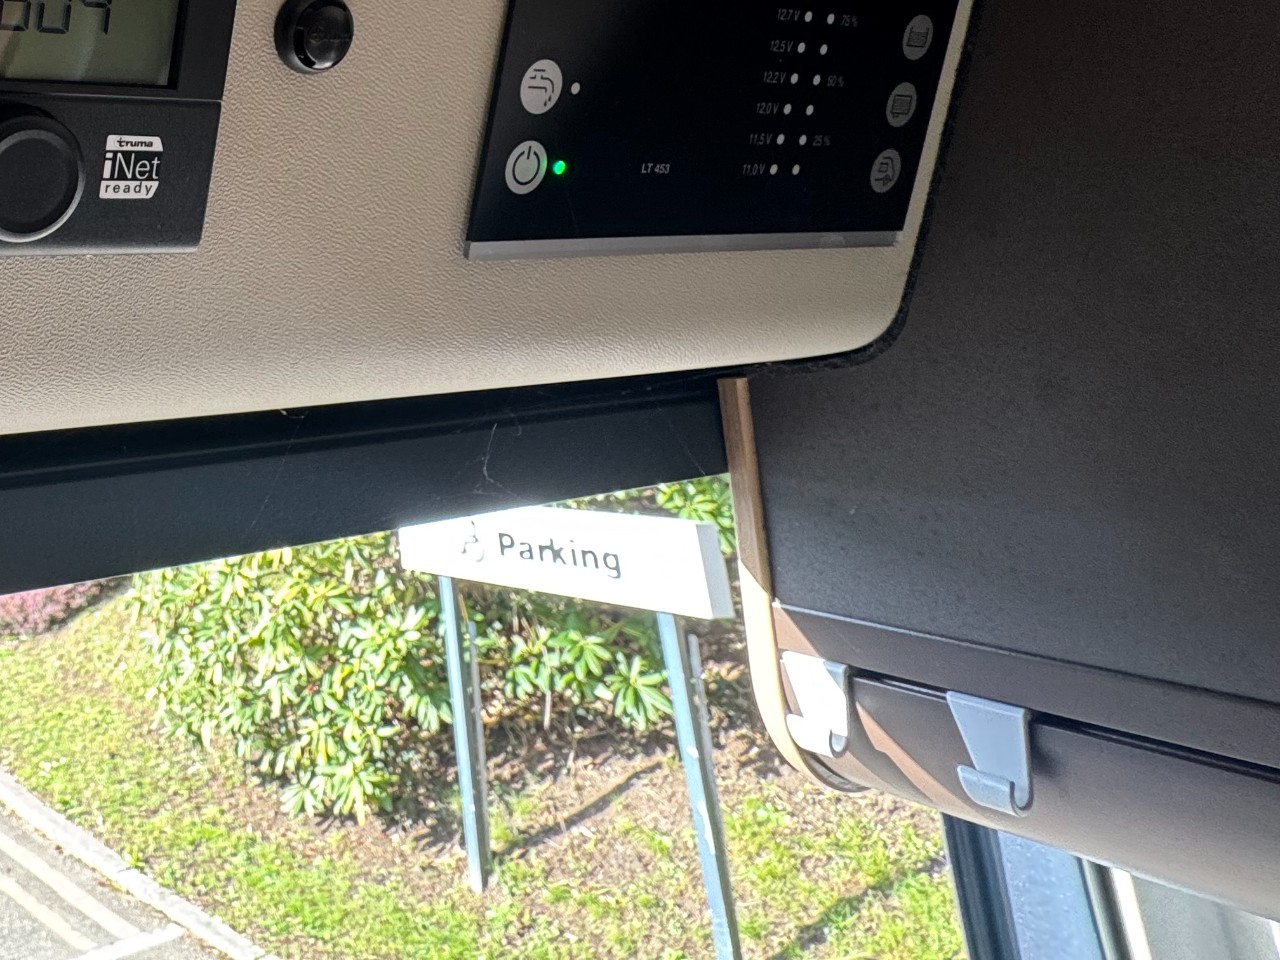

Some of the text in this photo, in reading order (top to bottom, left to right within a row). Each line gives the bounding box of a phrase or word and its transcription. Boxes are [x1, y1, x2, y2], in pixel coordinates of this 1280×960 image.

[116, 136, 154, 148] truma
[103, 152, 161, 180] iNet
[654, 163, 671, 175] 453
[104, 180, 153, 197] ready
[498, 531, 622, 580] Parking
